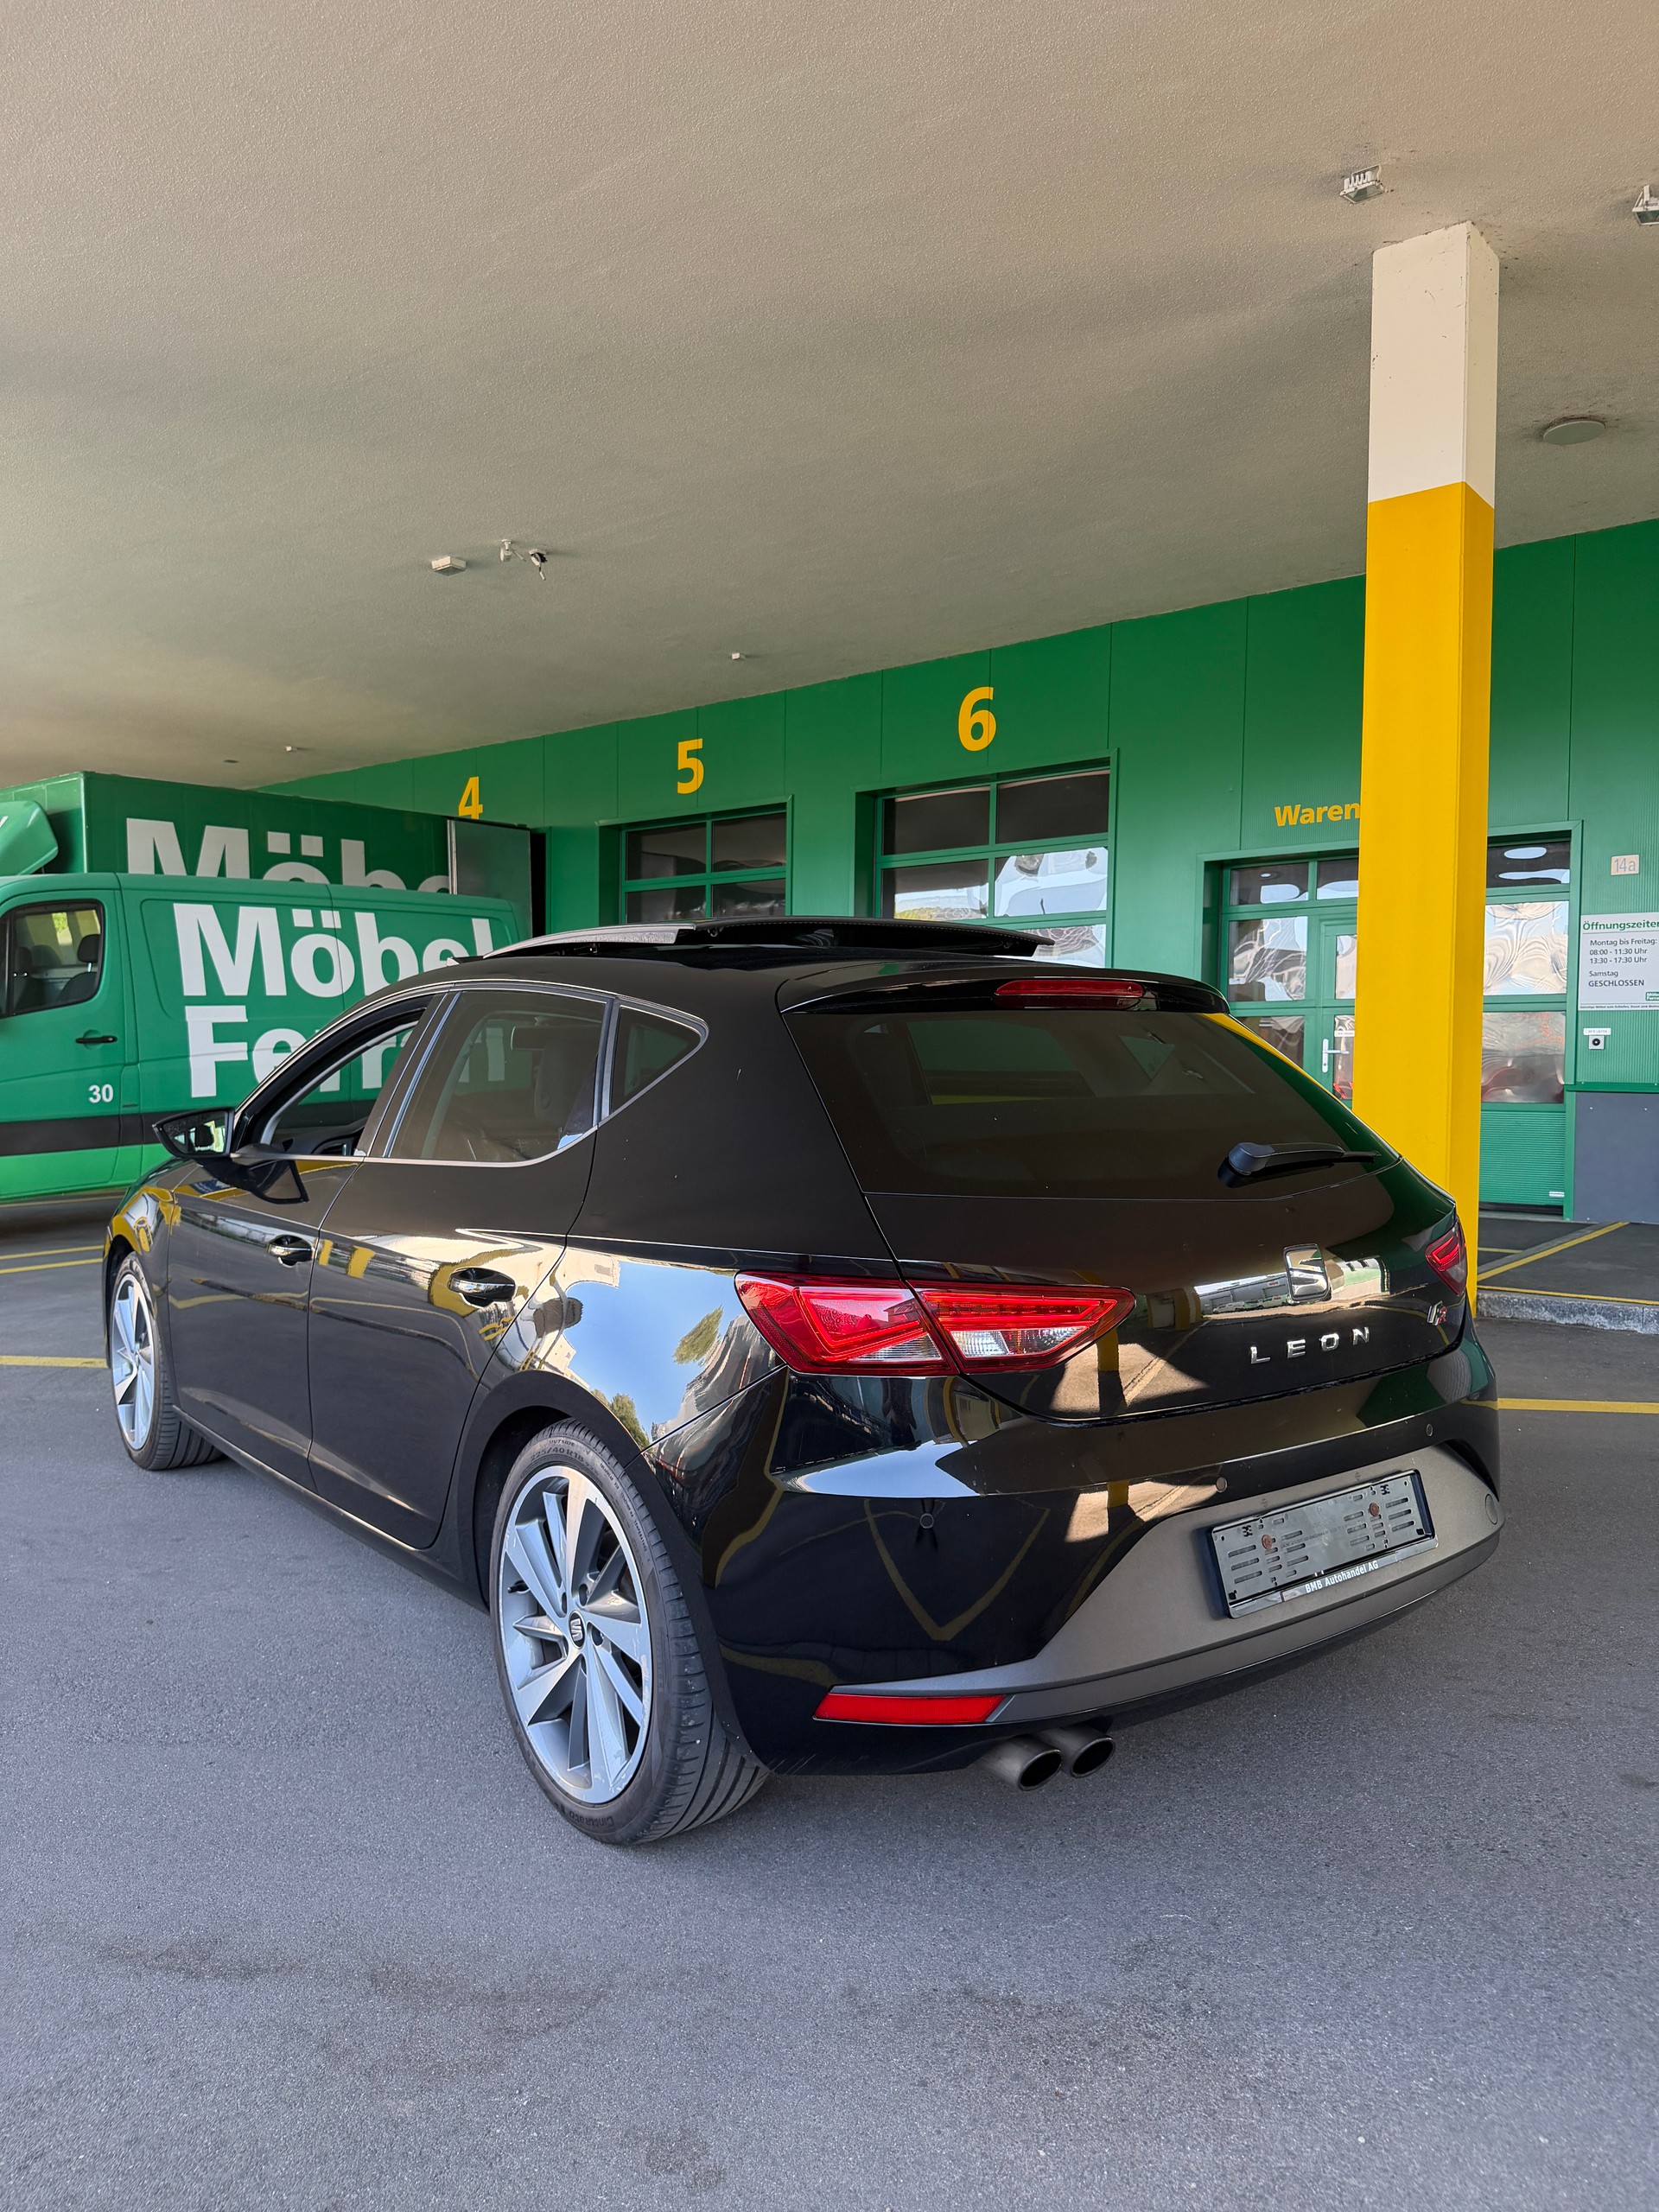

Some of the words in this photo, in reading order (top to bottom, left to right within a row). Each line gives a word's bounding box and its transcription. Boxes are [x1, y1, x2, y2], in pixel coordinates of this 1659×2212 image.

[958, 686, 996, 752] 6
[677, 738, 704, 794] 5
[458, 776, 483, 819] 4
[1274, 803, 1360, 827] Waren
[1614, 858, 1636, 872] 14a
[88, 1084, 114, 1103] 30
[1250, 1326, 1370, 1364] LEON
[1305, 1581, 1323, 1593] BMB
[1325, 1564, 1367, 1586] Autohandel
[1368, 1560, 1379, 1571] AG
